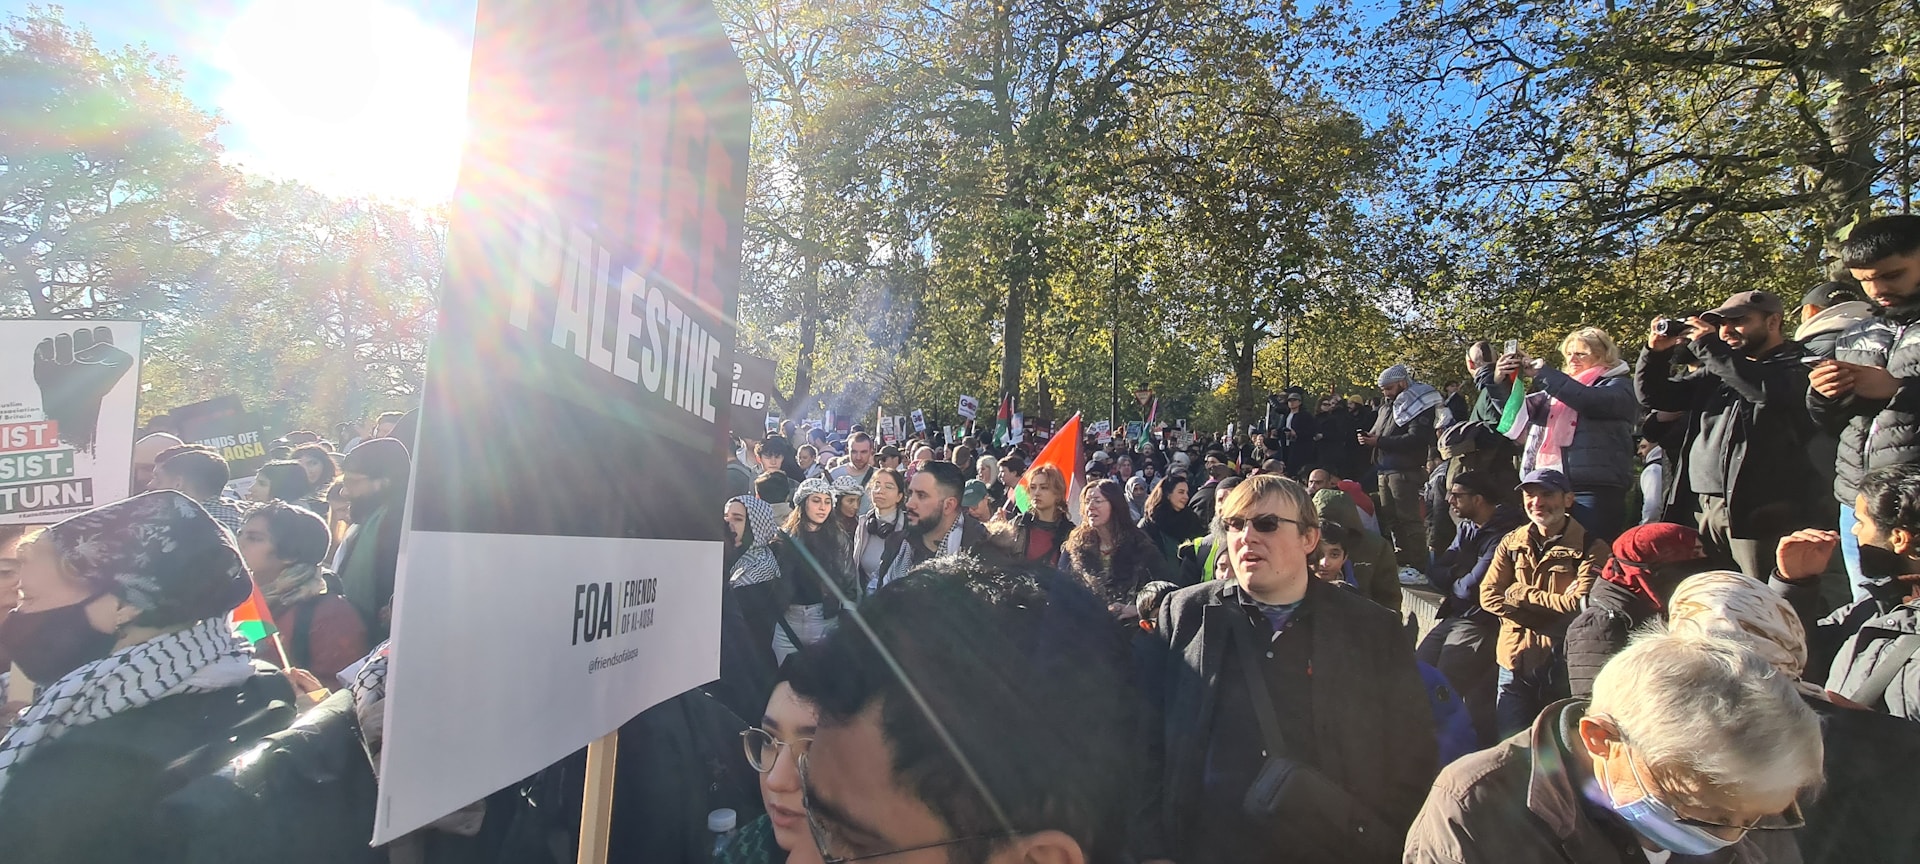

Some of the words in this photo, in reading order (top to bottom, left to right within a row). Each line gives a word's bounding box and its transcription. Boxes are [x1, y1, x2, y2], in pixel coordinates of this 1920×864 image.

[509, 198, 721, 424] PALESTINE
[238, 431, 259, 444] OFF
[623, 577, 657, 608] FRIENDS
[572, 582, 612, 646] FOA
[621, 613, 630, 634] OF
[631, 608, 654, 632] AL-AQSA
